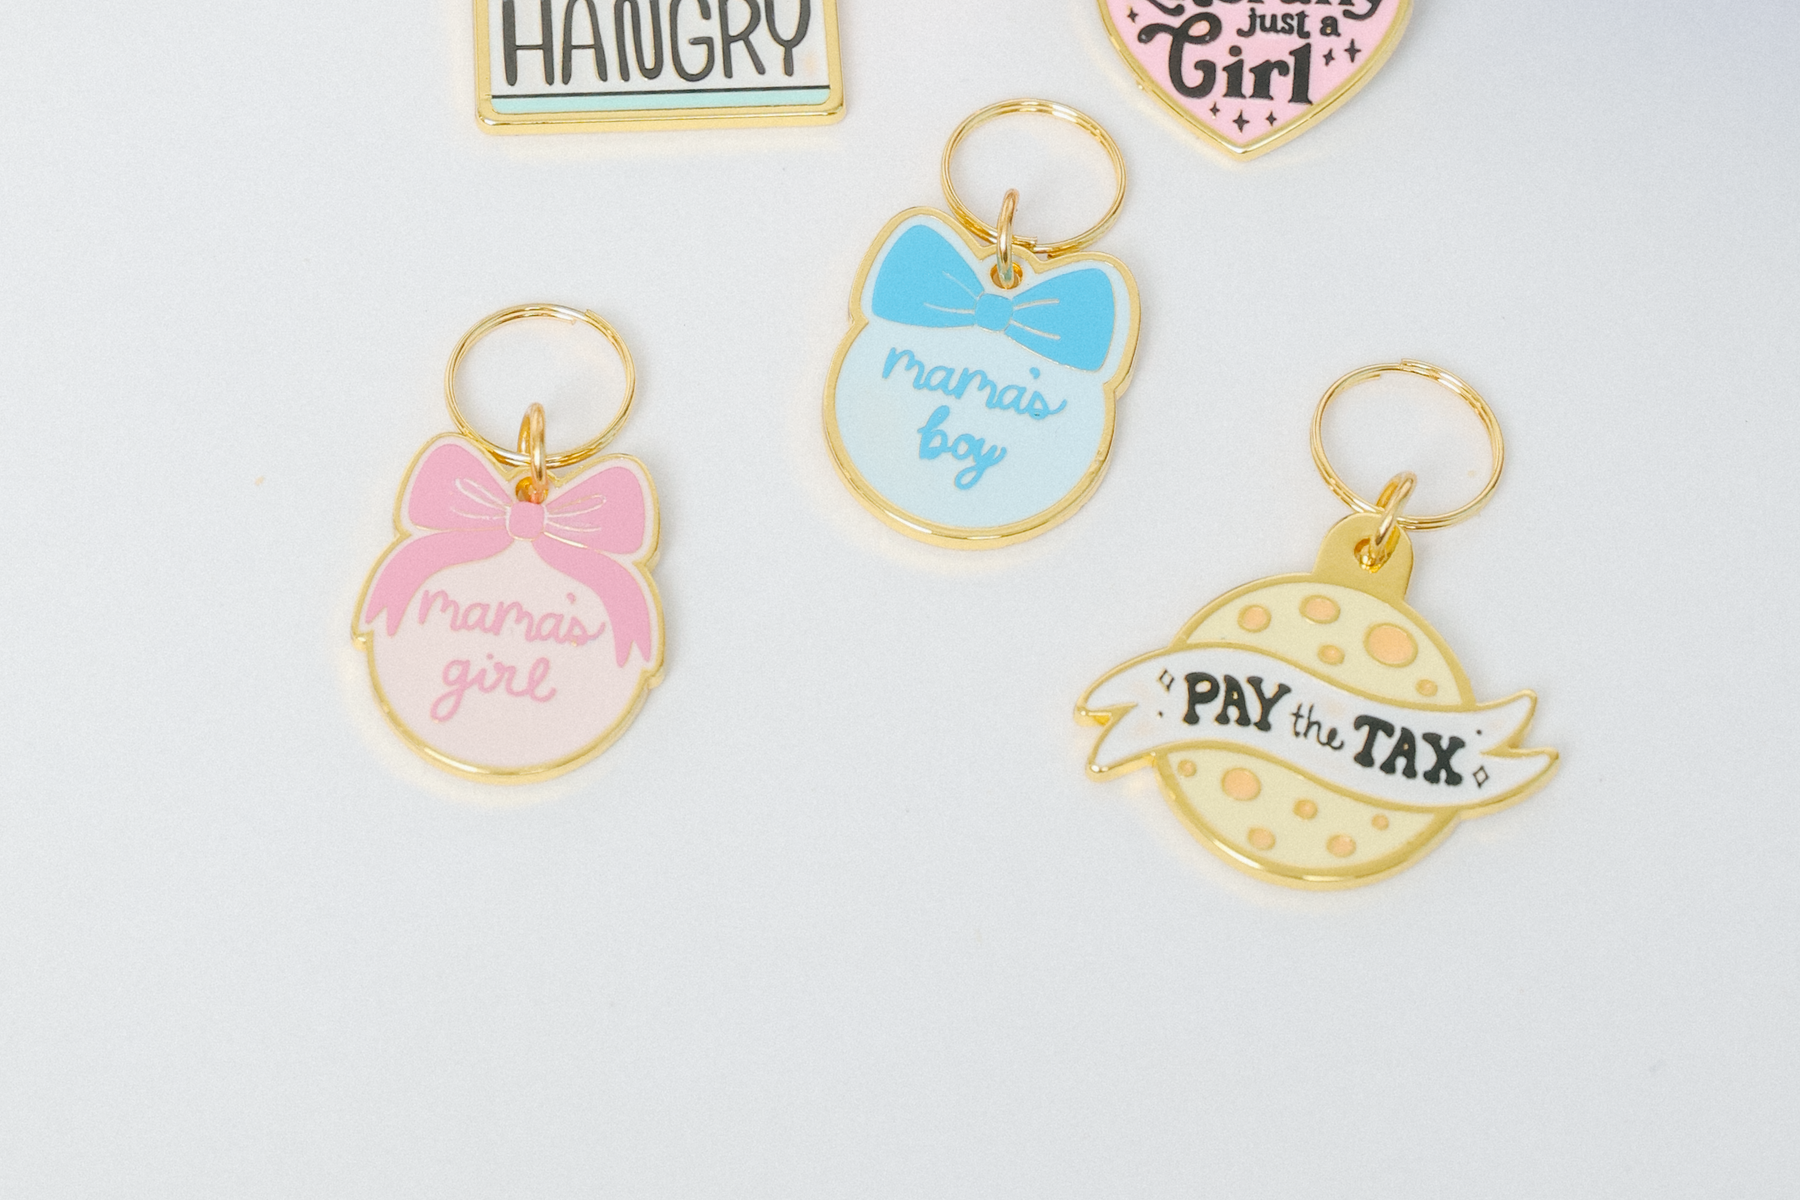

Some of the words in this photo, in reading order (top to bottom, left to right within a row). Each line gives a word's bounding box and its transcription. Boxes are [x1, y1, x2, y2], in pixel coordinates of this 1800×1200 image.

[1137, 11, 1314, 106] Girl
[1236, 7, 1311, 39] just
[1320, 15, 1341, 38] a
[881, 346, 1067, 420] mama's
[917, 404, 1007, 490] boy
[417, 589, 606, 646] mama's
[429, 653, 557, 723] girl
[1183, 671, 1292, 732] PAY
[1290, 702, 1345, 752] the
[1353, 714, 1466, 787] TAX
